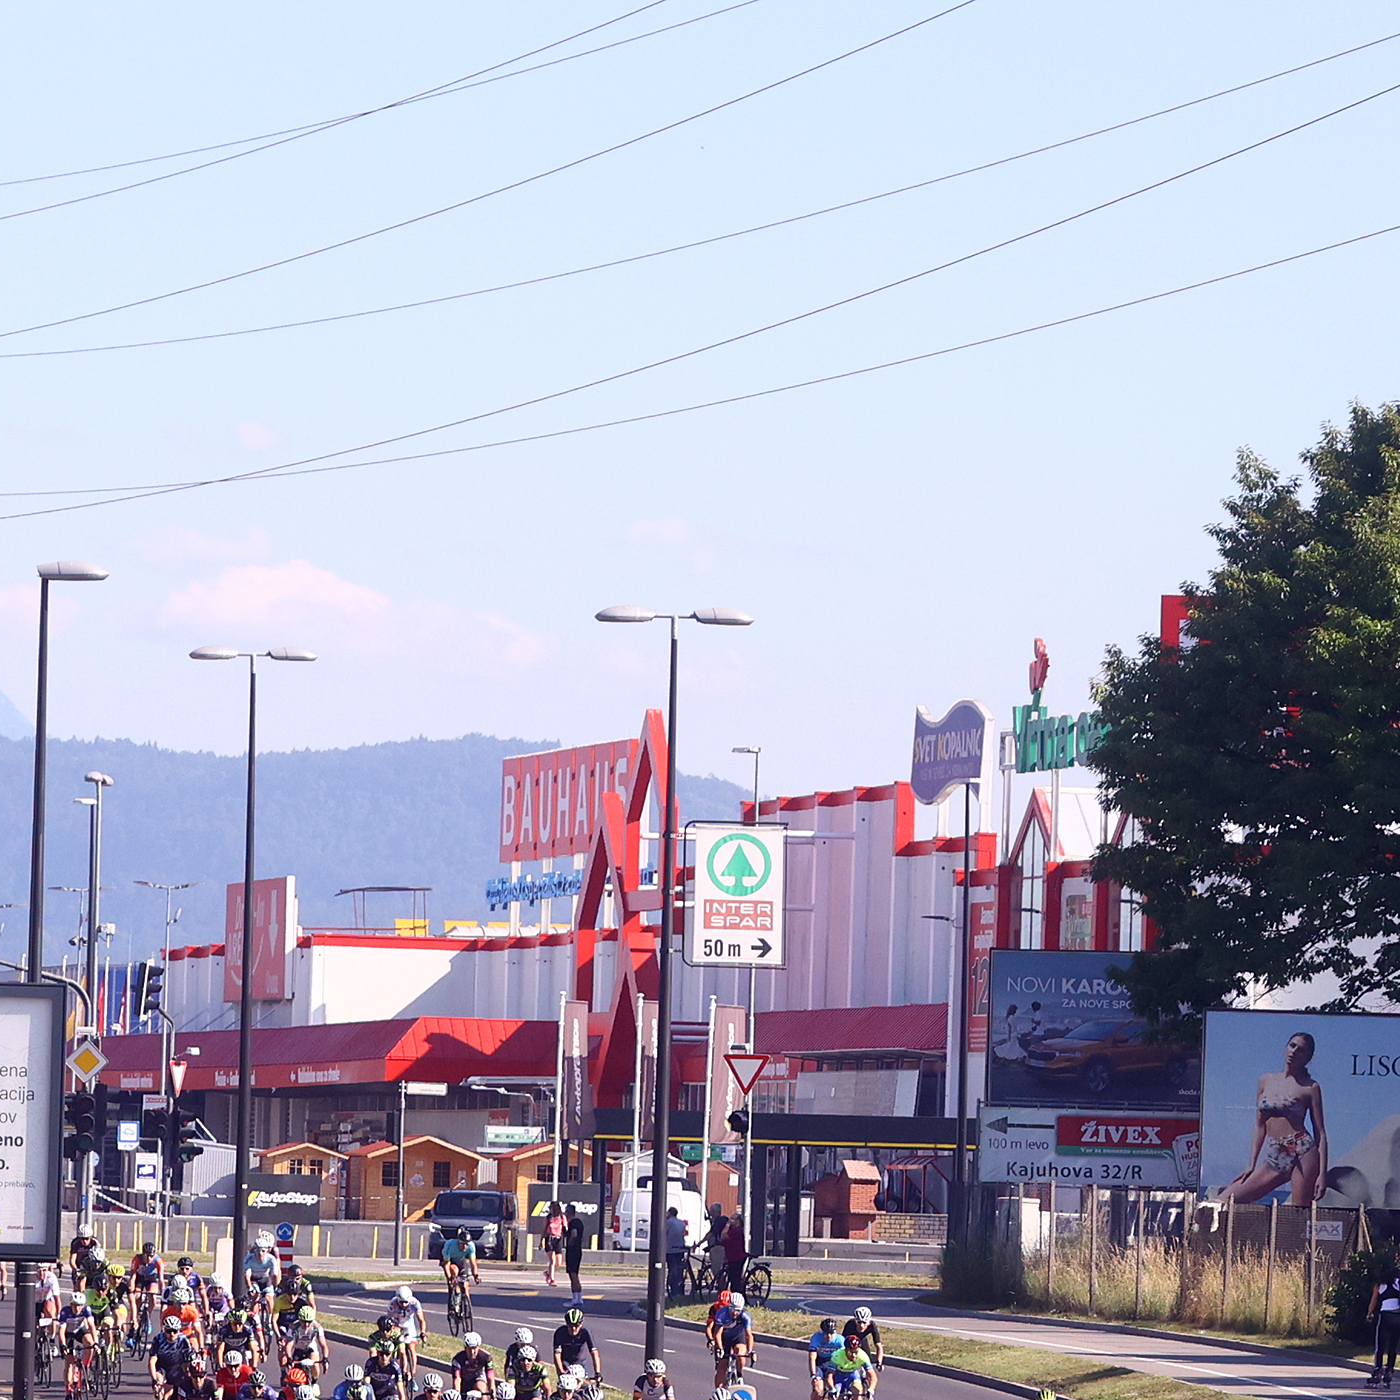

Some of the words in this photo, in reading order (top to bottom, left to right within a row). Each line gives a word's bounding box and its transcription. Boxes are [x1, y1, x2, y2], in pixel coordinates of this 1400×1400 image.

[914, 734, 937, 763] SVET
[937, 727, 982, 761] KOPALNIC
[705, 902, 772, 915] INTER
[710, 915, 772, 928] SPAR
[703, 939, 724, 957] 50
[728, 943, 741, 957] m
[1007, 977, 1055, 993] NOVI
[1062, 999, 1077, 1009] ZA
[1079, 999, 1110, 1009] NOVE
[1080, 1120, 1162, 1144] ŽIVEX
[988, 1138, 1007, 1149] 100
[1010, 1140, 1023, 1149] m
[1025, 1138, 1049, 1150] levo
[1006, 1161, 1093, 1180] Kajuhova
[1100, 1164, 1143, 1180] 32/R
